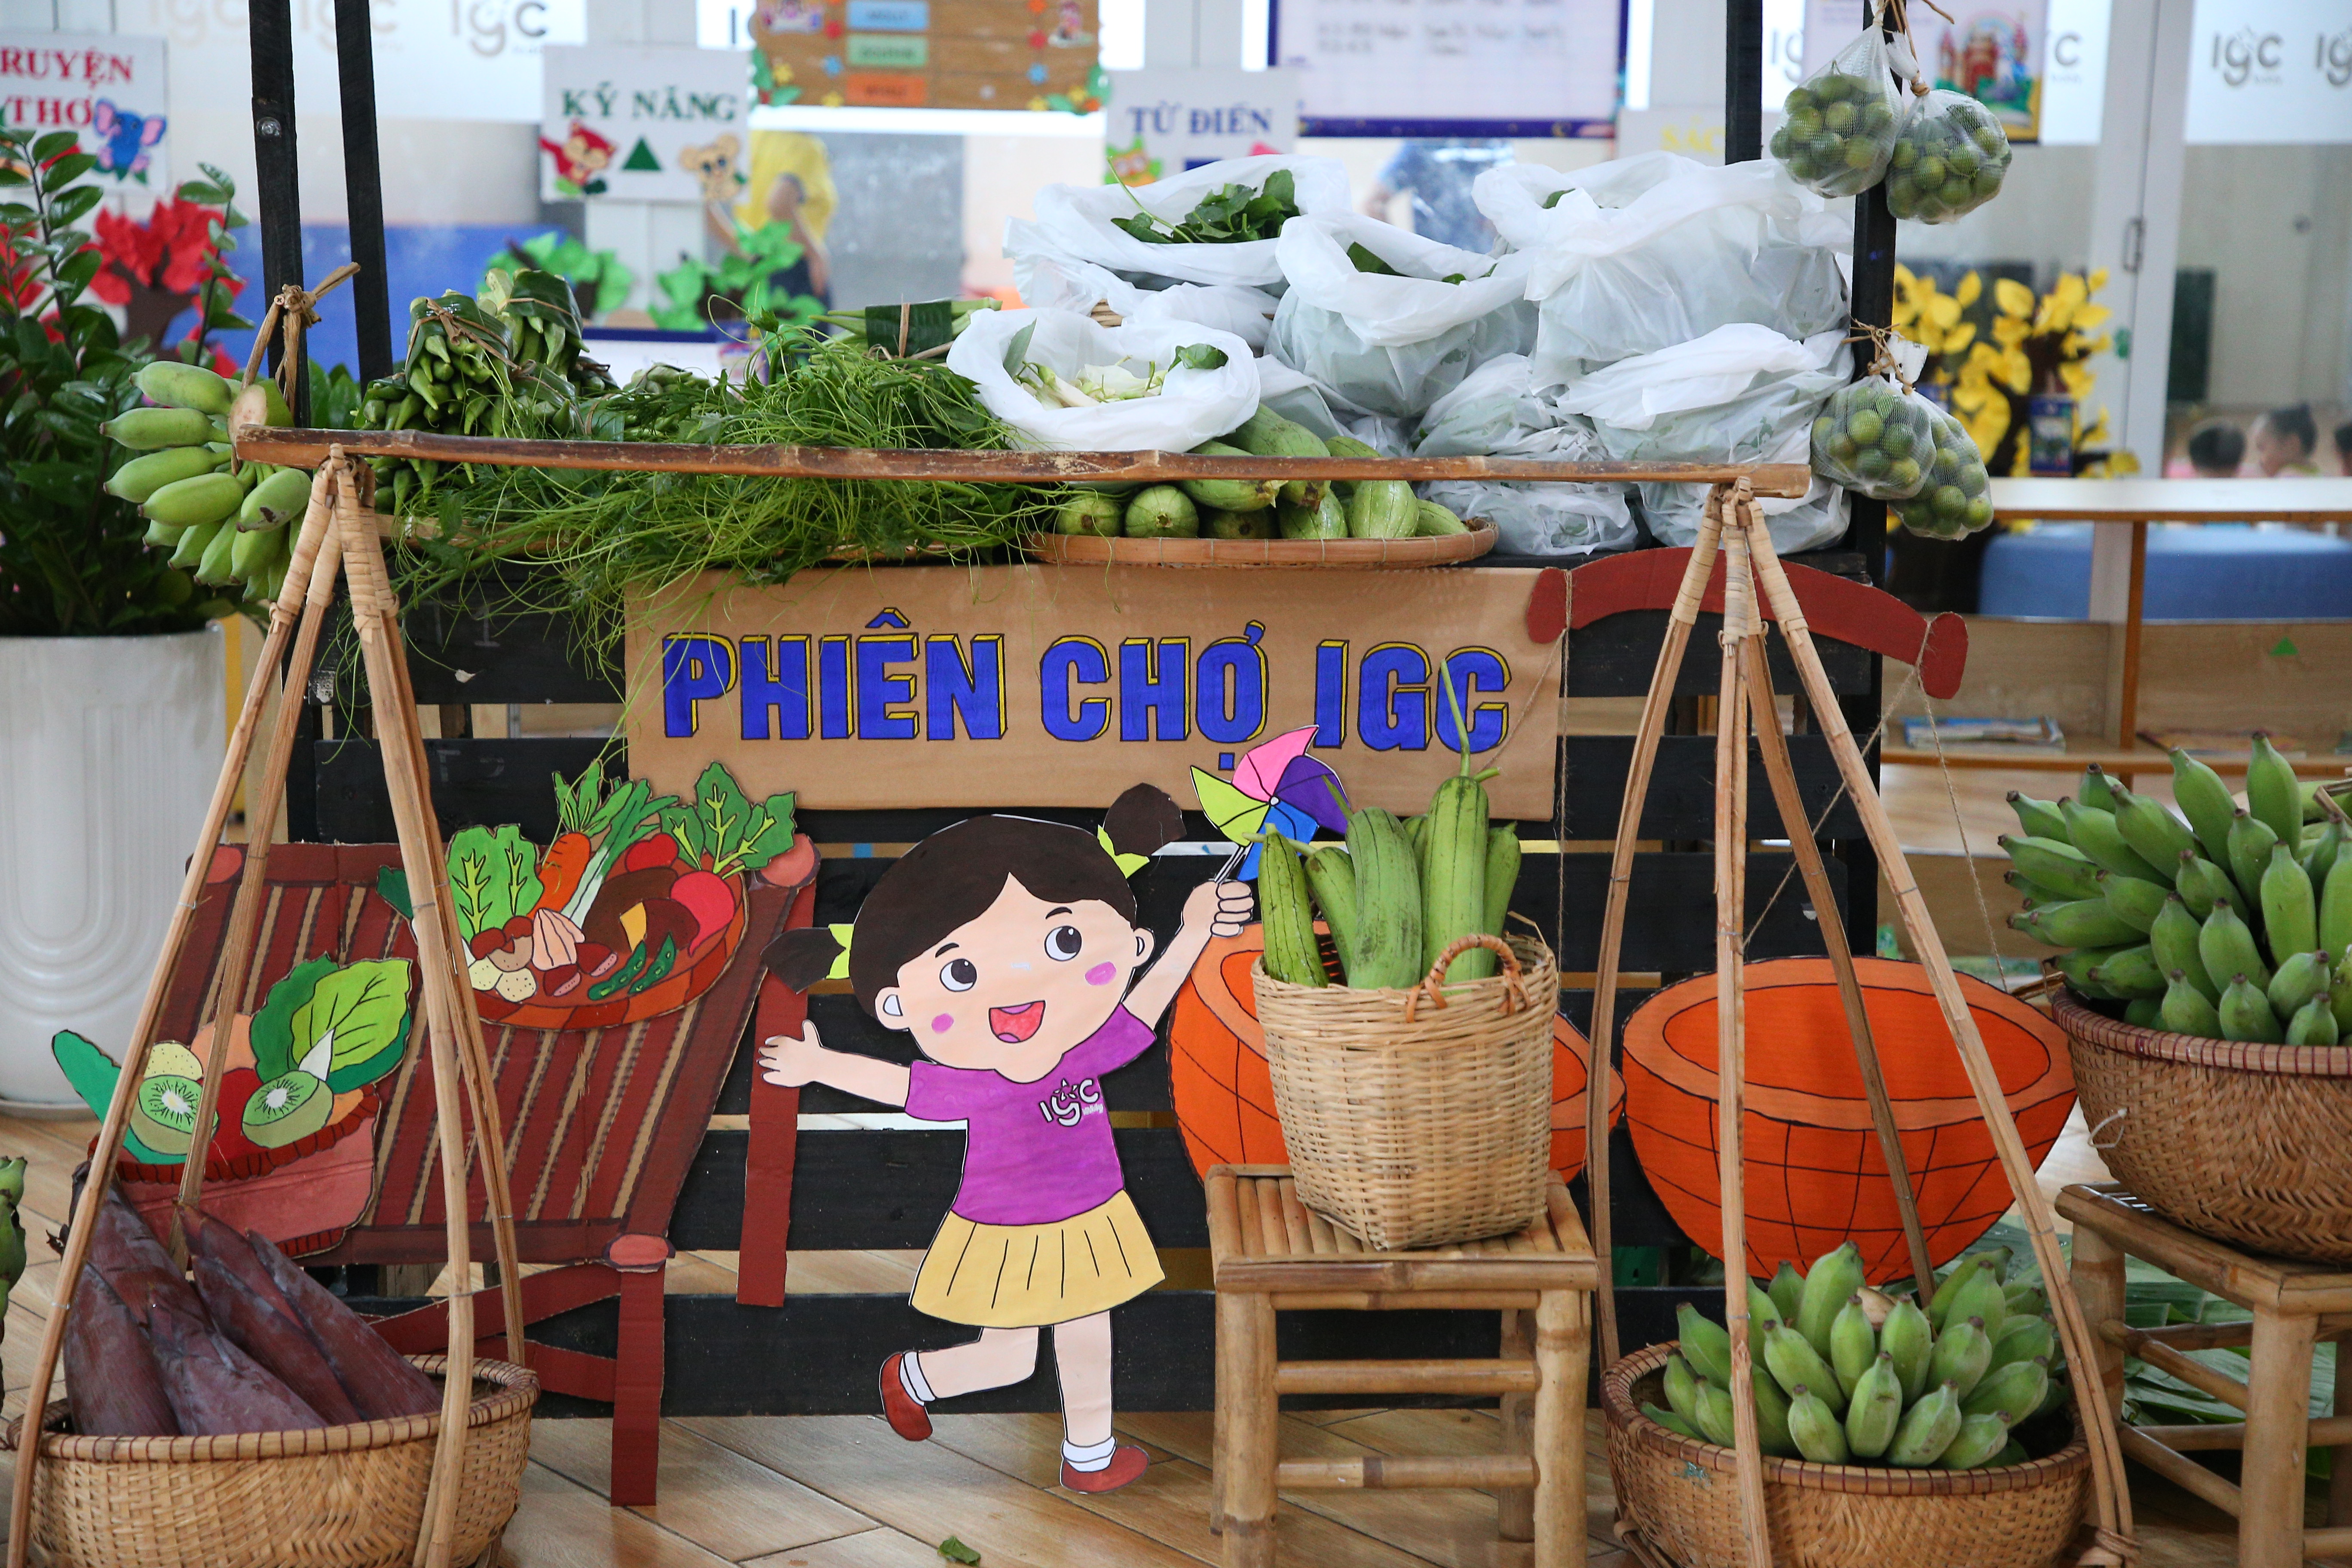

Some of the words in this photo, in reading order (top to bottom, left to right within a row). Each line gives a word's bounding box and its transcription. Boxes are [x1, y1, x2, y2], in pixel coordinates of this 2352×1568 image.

[0, 46, 133, 89] RUYỆN
[5, 94, 93, 127] THƠ
[633, 85, 738, 122] NĂNG
[1661, 115, 1726, 152] SÁC
[662, 607, 1008, 741] PHIÊN
[1039, 619, 1269, 770] CHỢ
[1313, 639, 1512, 754] IGC
